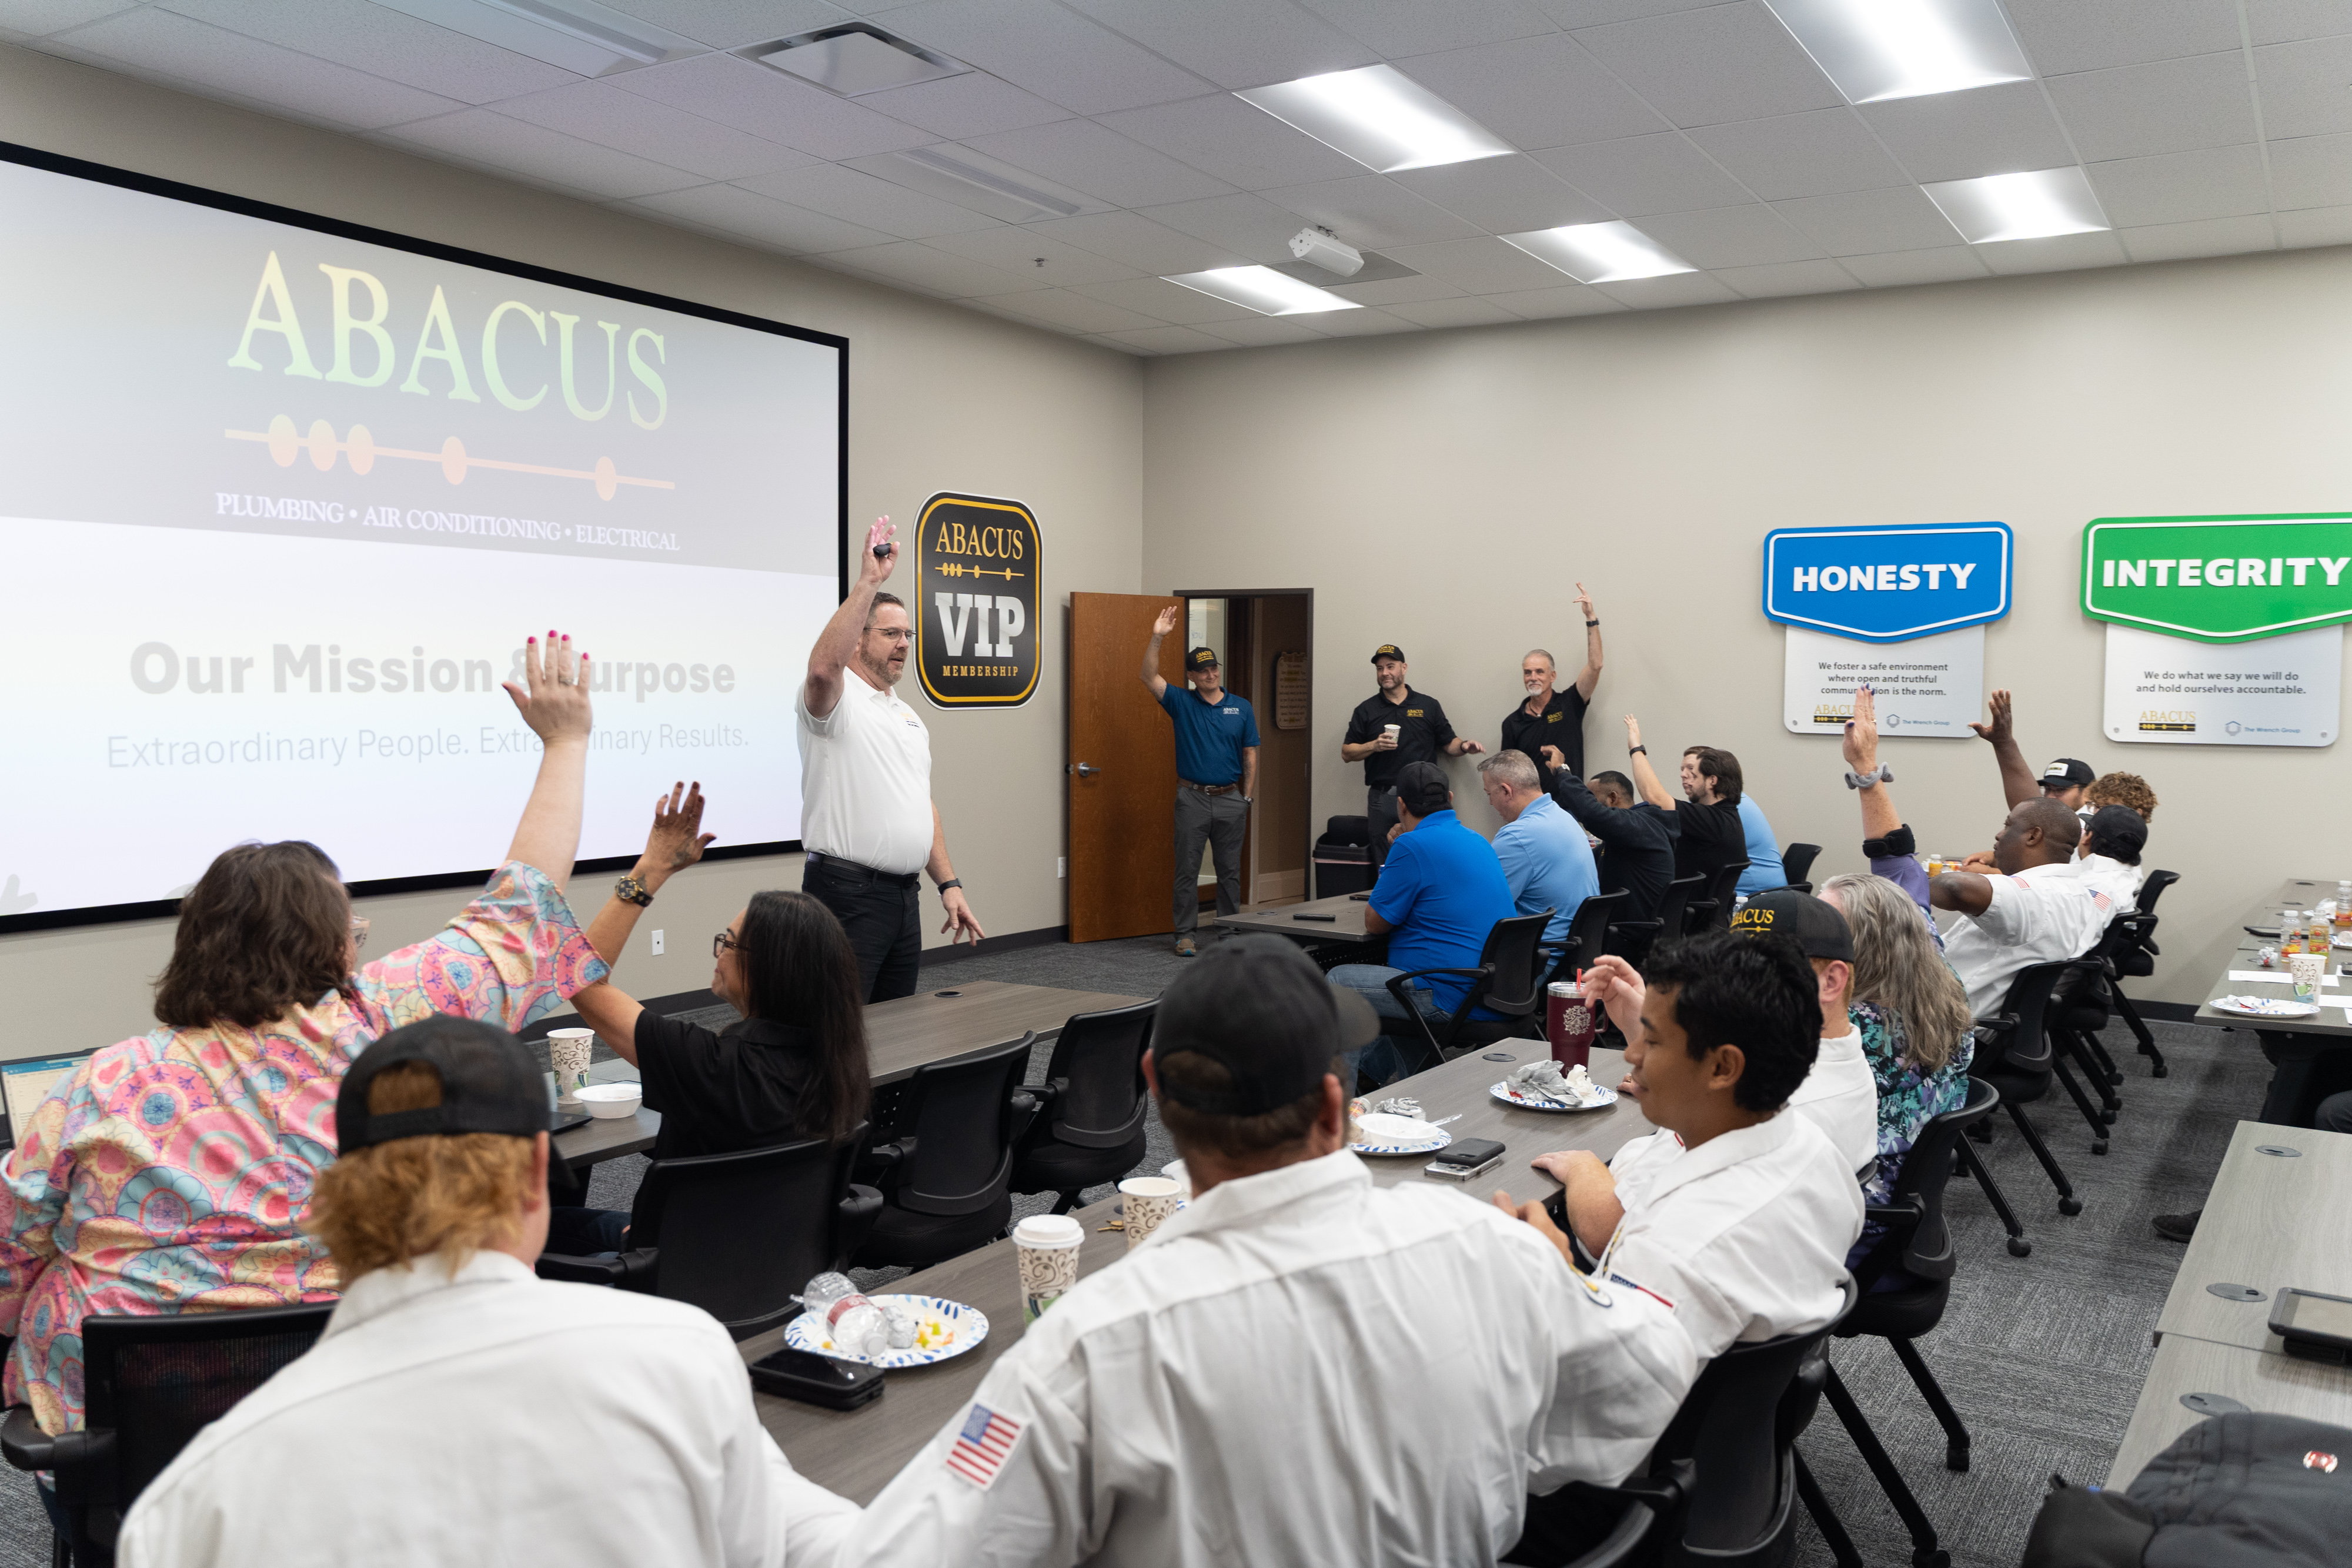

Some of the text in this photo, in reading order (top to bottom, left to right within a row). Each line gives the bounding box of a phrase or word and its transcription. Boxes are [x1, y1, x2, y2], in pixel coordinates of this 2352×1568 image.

[228, 250, 668, 431] ABACUS
[215, 492, 681, 551] PLUMBING AIR CONDITIONING ELECTRICAL
[935, 521, 1023, 560] ABACUS
[1793, 563, 1977, 592] HONESTY
[2103, 557, 2351, 587] INTEGRITY
[935, 591, 1025, 657] VIP
[129, 641, 255, 694] Our
[273, 644, 493, 693] Mission
[943, 665, 1018, 677] MEMBERSHIP
[1819, 662, 1832, 670] We
[1833, 662, 1859, 670] foster
[1869, 662, 1887, 671] safe
[1889, 662, 1949, 671] environment
[1828, 674, 1855, 683] where
[1857, 676, 1880, 684] open
[1902, 675, 1937, 683] truthful
[2144, 671, 2159, 680] We
[2162, 671, 2176, 680] do
[2177, 671, 2204, 680] what
[2224, 673, 2242, 681] say
[2263, 671, 2282, 680] will
[2285, 671, 2299, 680] do
[2136, 684, 2306, 694] and hold ourselves accountable.
[1814, 705, 1855, 714] ABACU
[2139, 710, 2196, 722] ABACUS
[108, 723, 749, 768] Extraordinary People. Extrainary Results.
